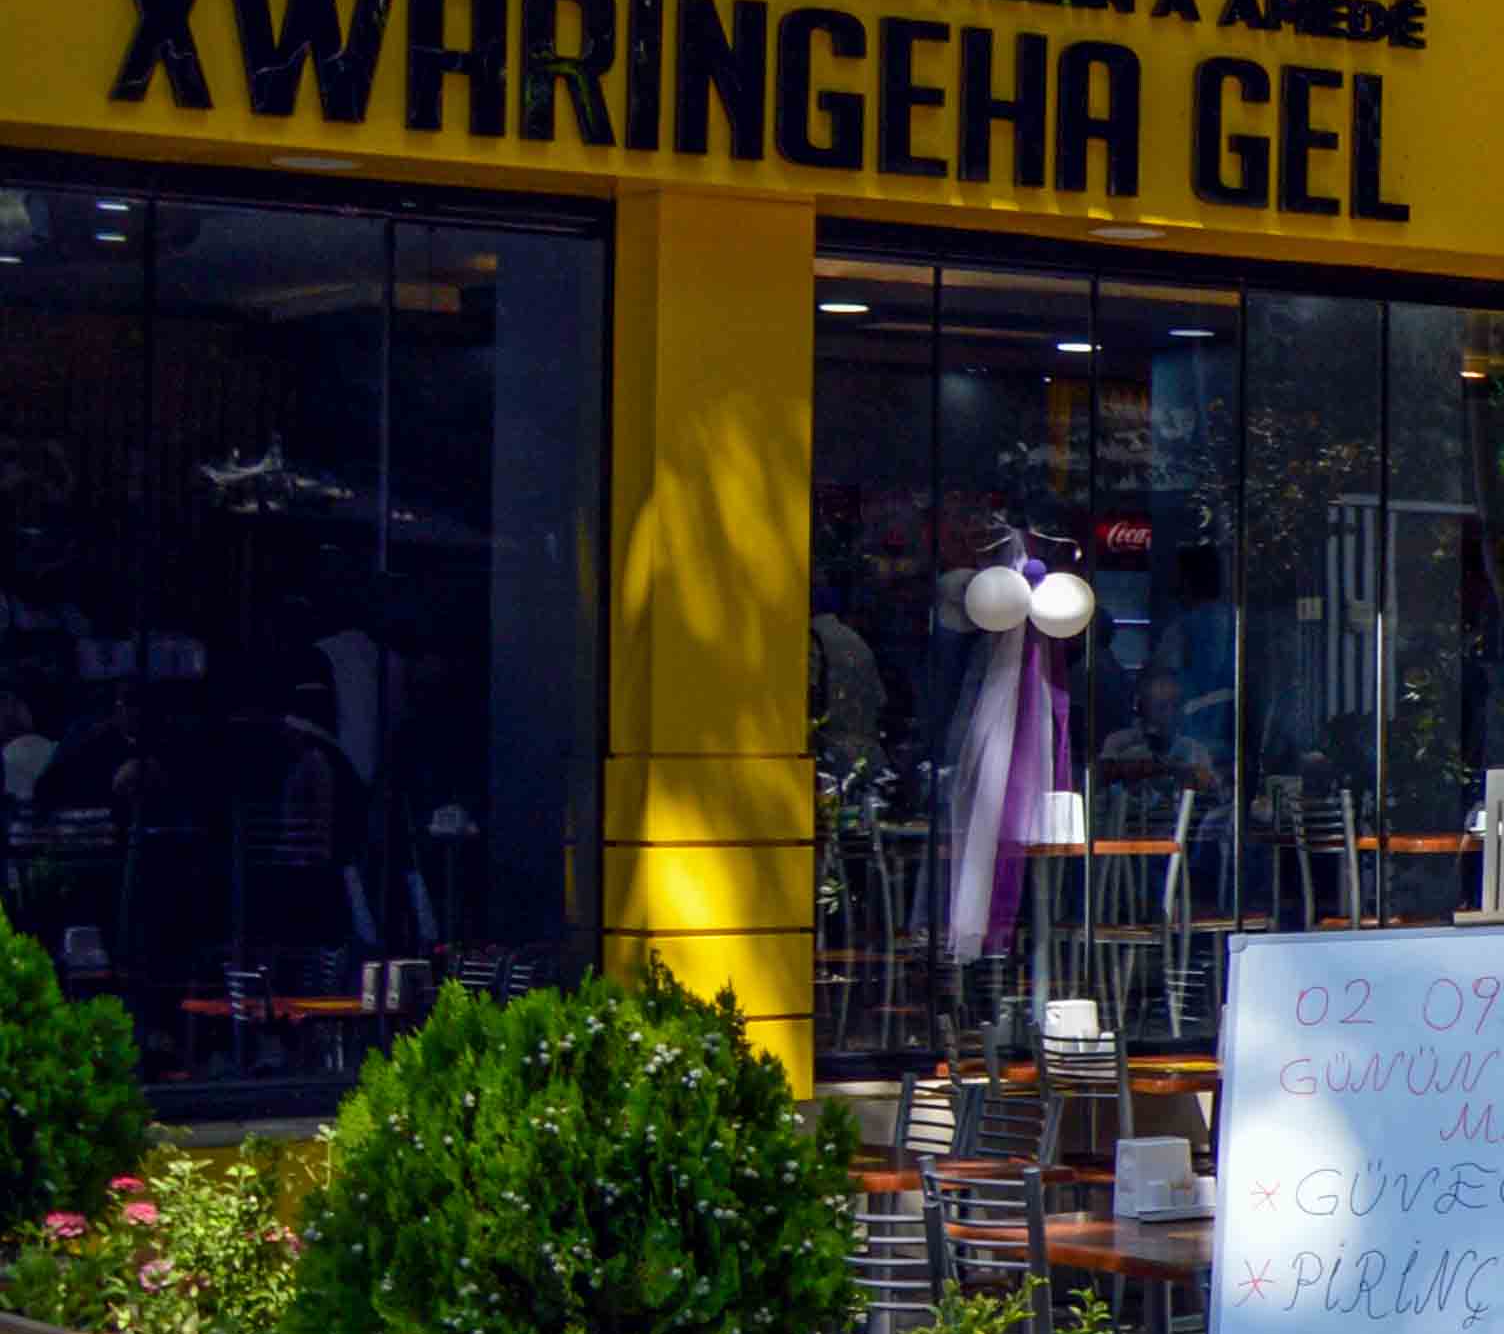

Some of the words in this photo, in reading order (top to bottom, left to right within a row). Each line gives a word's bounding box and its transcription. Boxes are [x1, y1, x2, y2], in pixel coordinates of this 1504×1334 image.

[1191, 55, 1412, 224] GEL
[1296, 978, 1375, 1027] 02
[1279, 1045, 1499, 1097] GÜNÜN
[1283, 1238, 1500, 1330] PİRİNÇ
